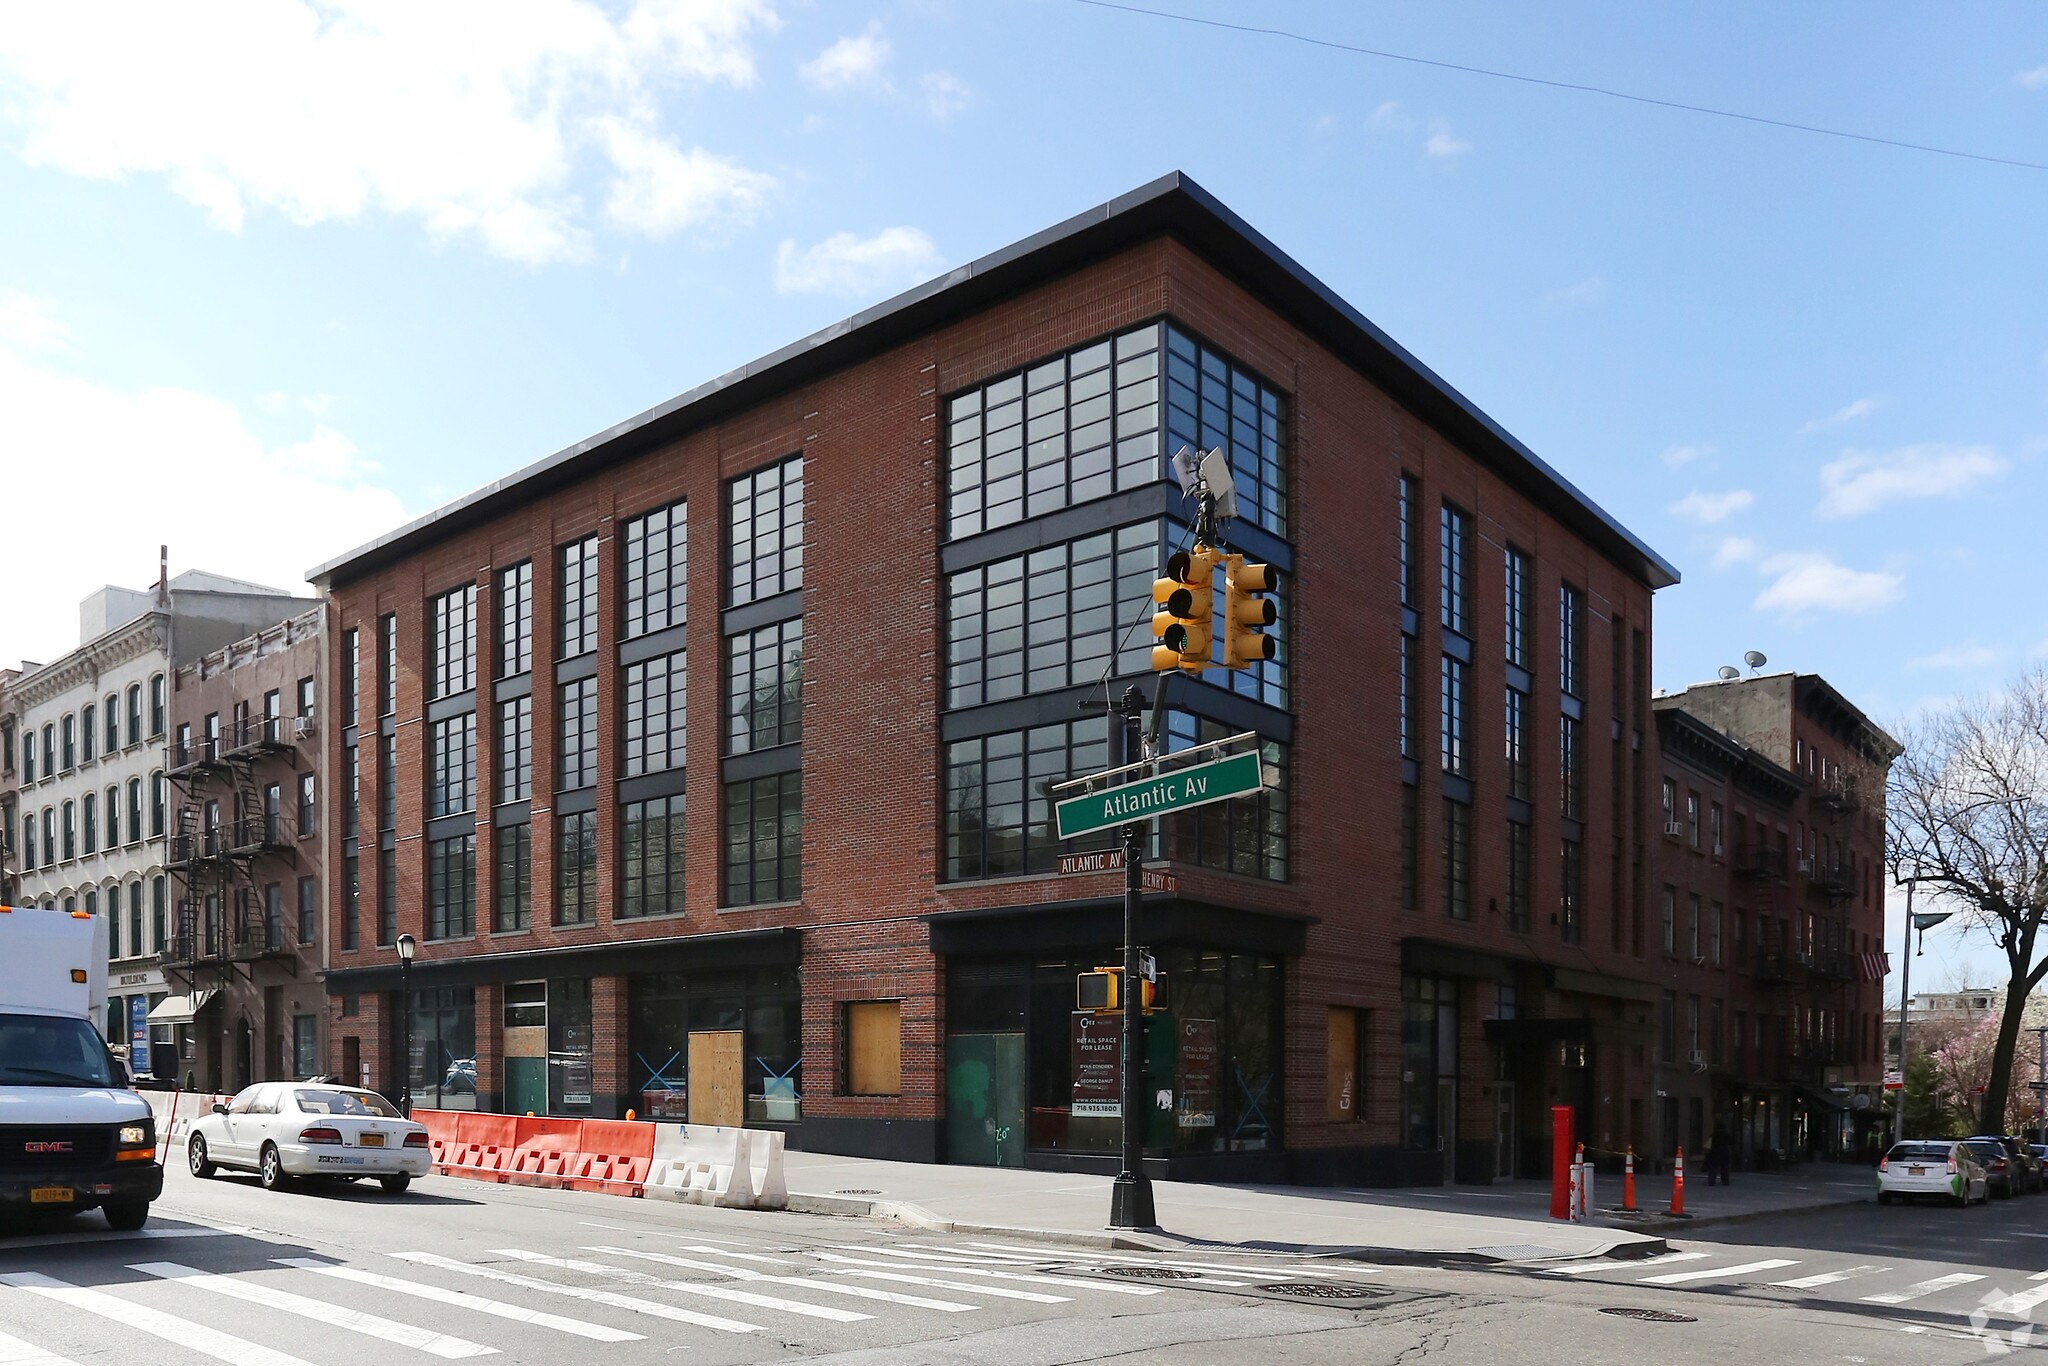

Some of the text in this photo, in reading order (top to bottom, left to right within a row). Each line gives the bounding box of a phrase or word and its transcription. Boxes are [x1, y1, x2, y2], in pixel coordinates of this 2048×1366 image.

[1104, 776, 1208, 818] Atlantic Av
[1061, 852, 1121, 874] ATLANTIC AV
[1142, 871, 1176, 891] HENRY ST
[120, 973, 147, 986] BUILDING
[25, 1141, 73, 1153] GMC
